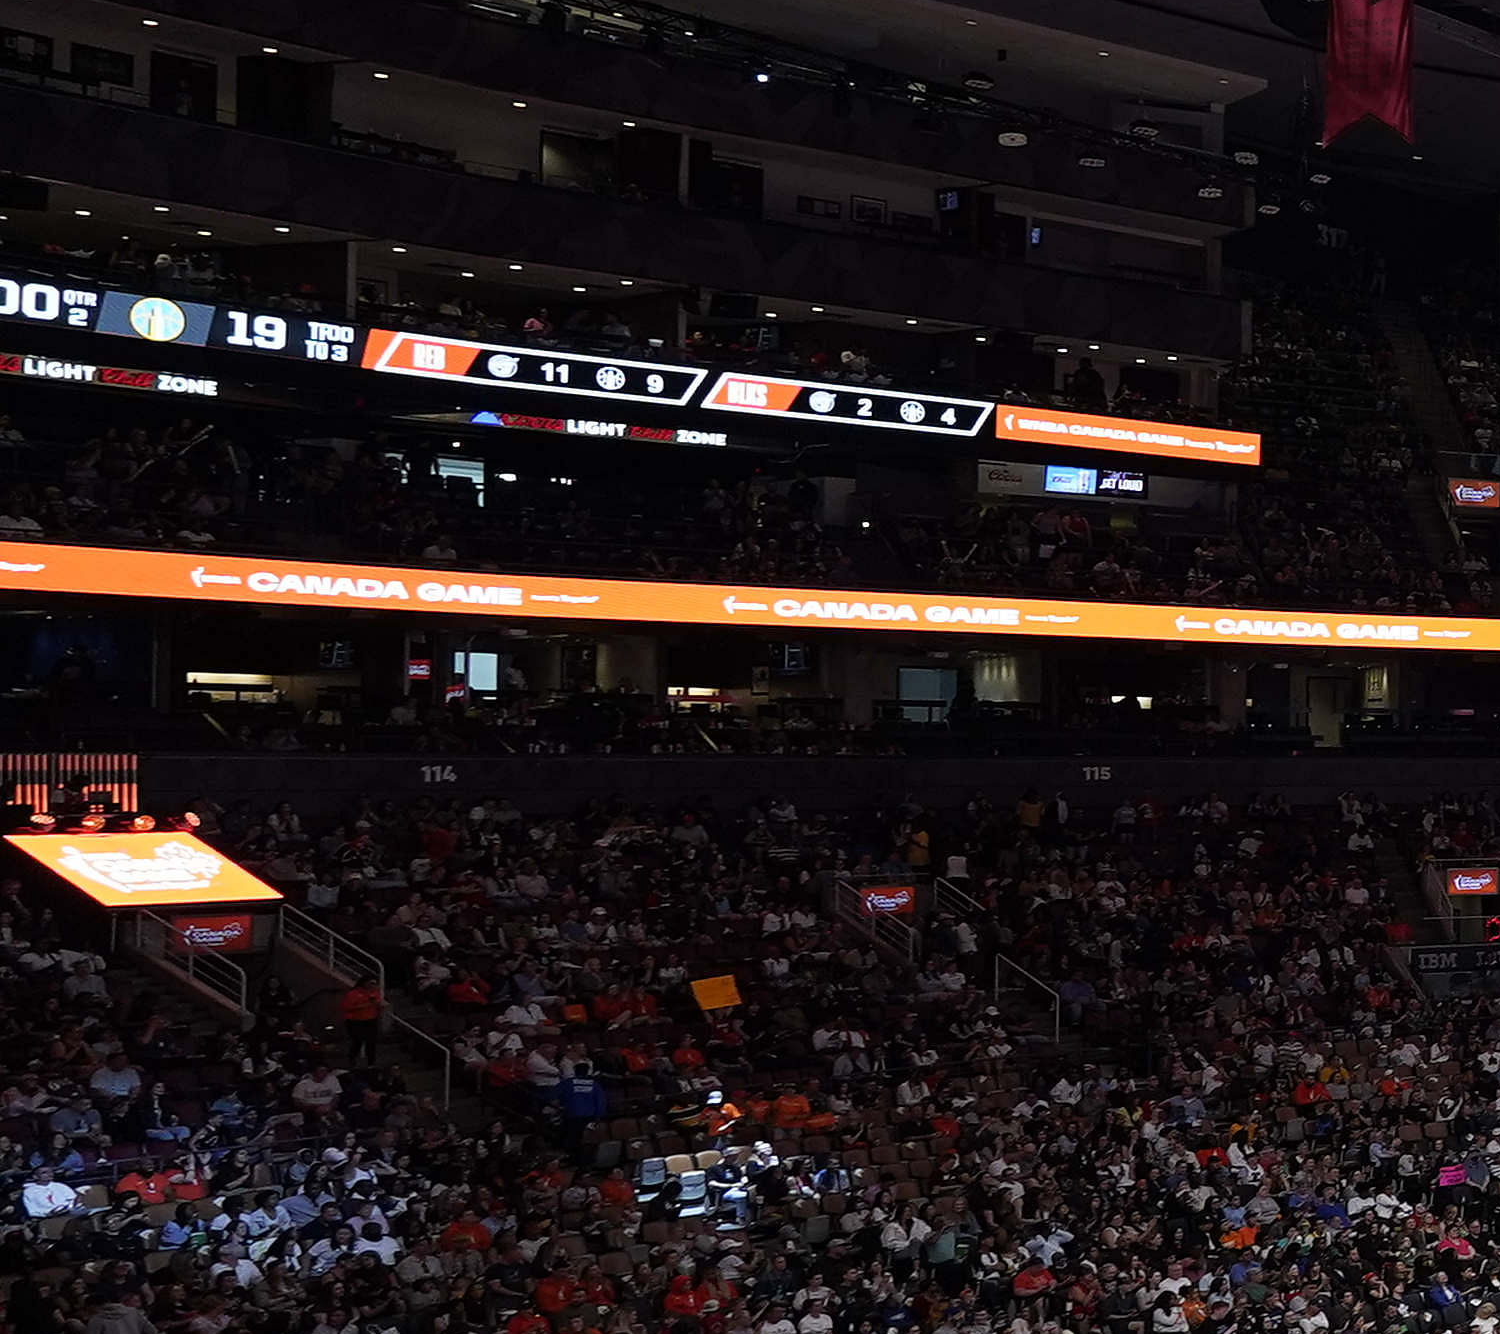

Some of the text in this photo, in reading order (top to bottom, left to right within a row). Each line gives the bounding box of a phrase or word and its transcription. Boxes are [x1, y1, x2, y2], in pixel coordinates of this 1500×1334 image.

[63, 289, 97, 307] QTR
[68, 307, 88, 327] 2
[226, 310, 288, 350] 19
[23, 358, 218, 397] LIGHT ZONE
[540, 362, 569, 383] 11
[646, 374, 664, 394] 9
[857, 398, 873, 417] 2
[940, 407, 957, 427] 4
[567, 418, 627, 437] LIGHT
[676, 429, 727, 446] ZONE
[247, 572, 523, 605] CANADA GAME
[773, 599, 1020, 626] CANADA GAME
[421, 766, 457, 782] 114
